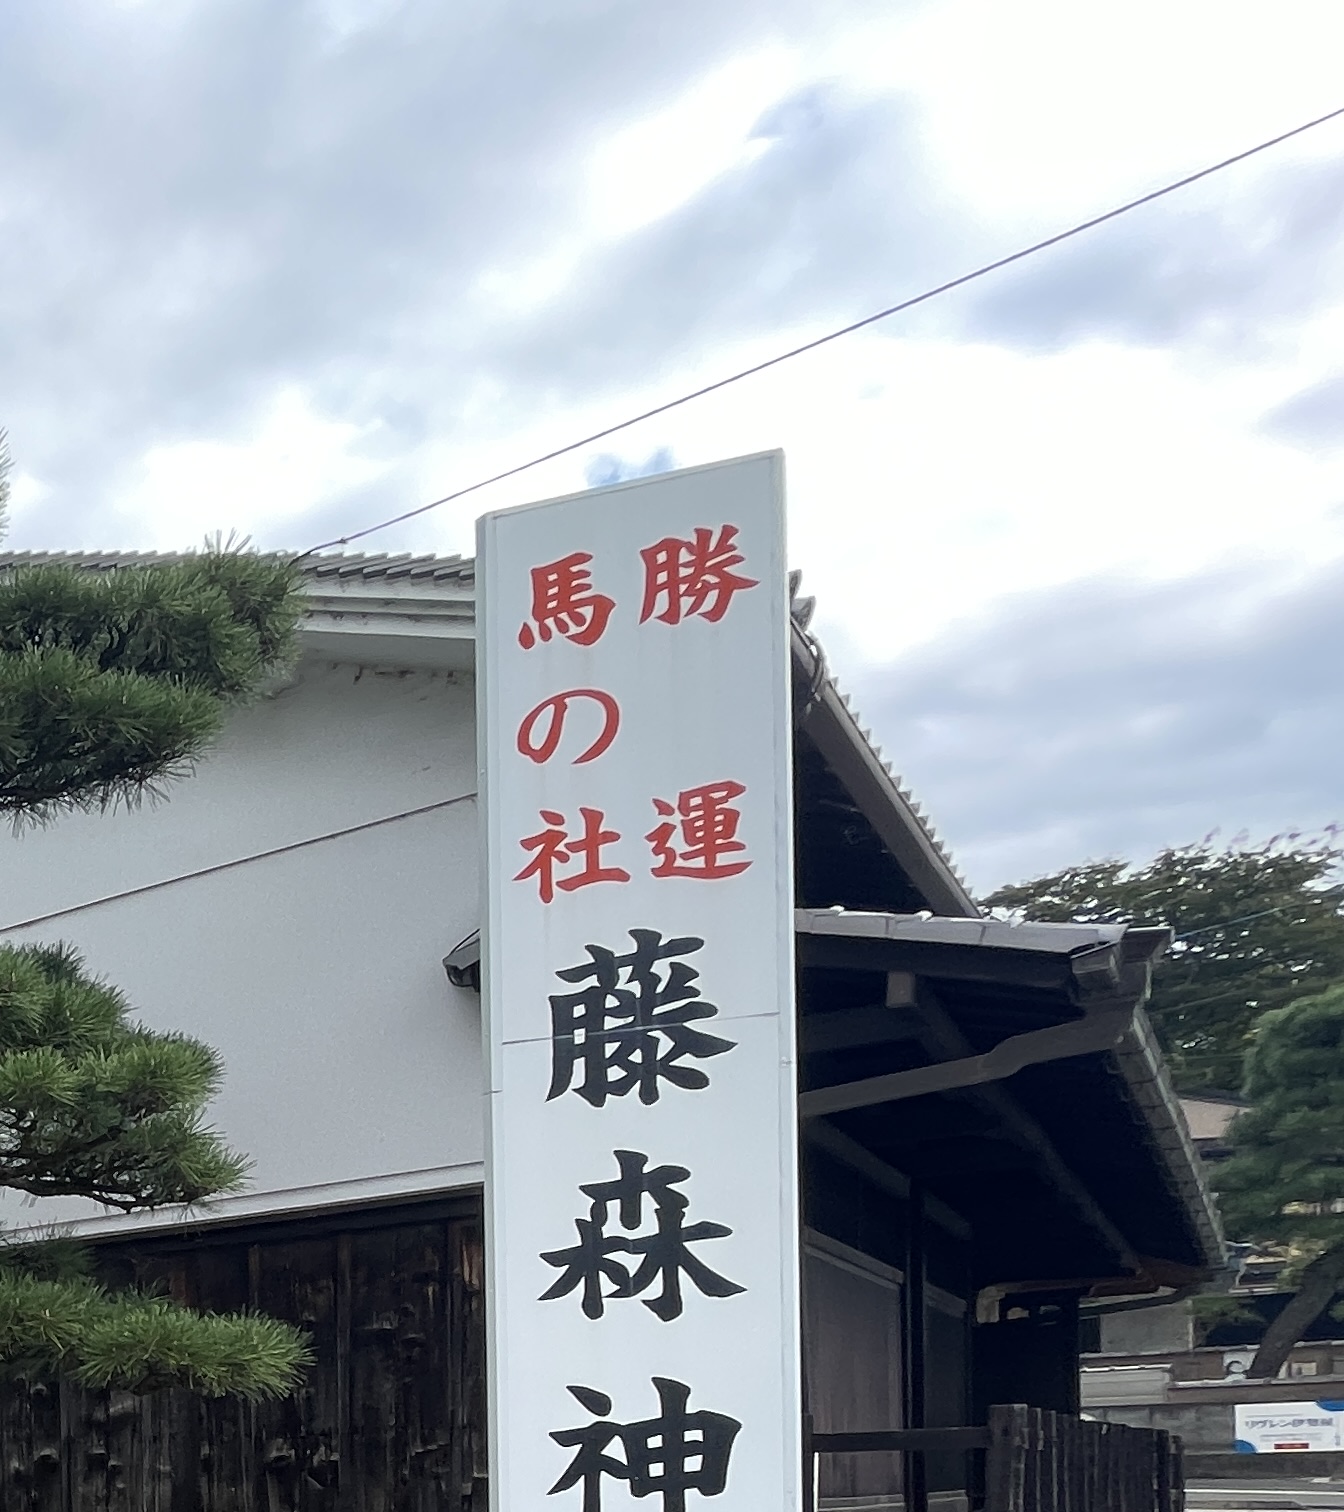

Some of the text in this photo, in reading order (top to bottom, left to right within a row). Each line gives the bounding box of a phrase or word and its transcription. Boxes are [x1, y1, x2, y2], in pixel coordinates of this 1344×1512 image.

[512, 551, 632, 904] 馬の社
[638, 524, 761, 881] 勝運
